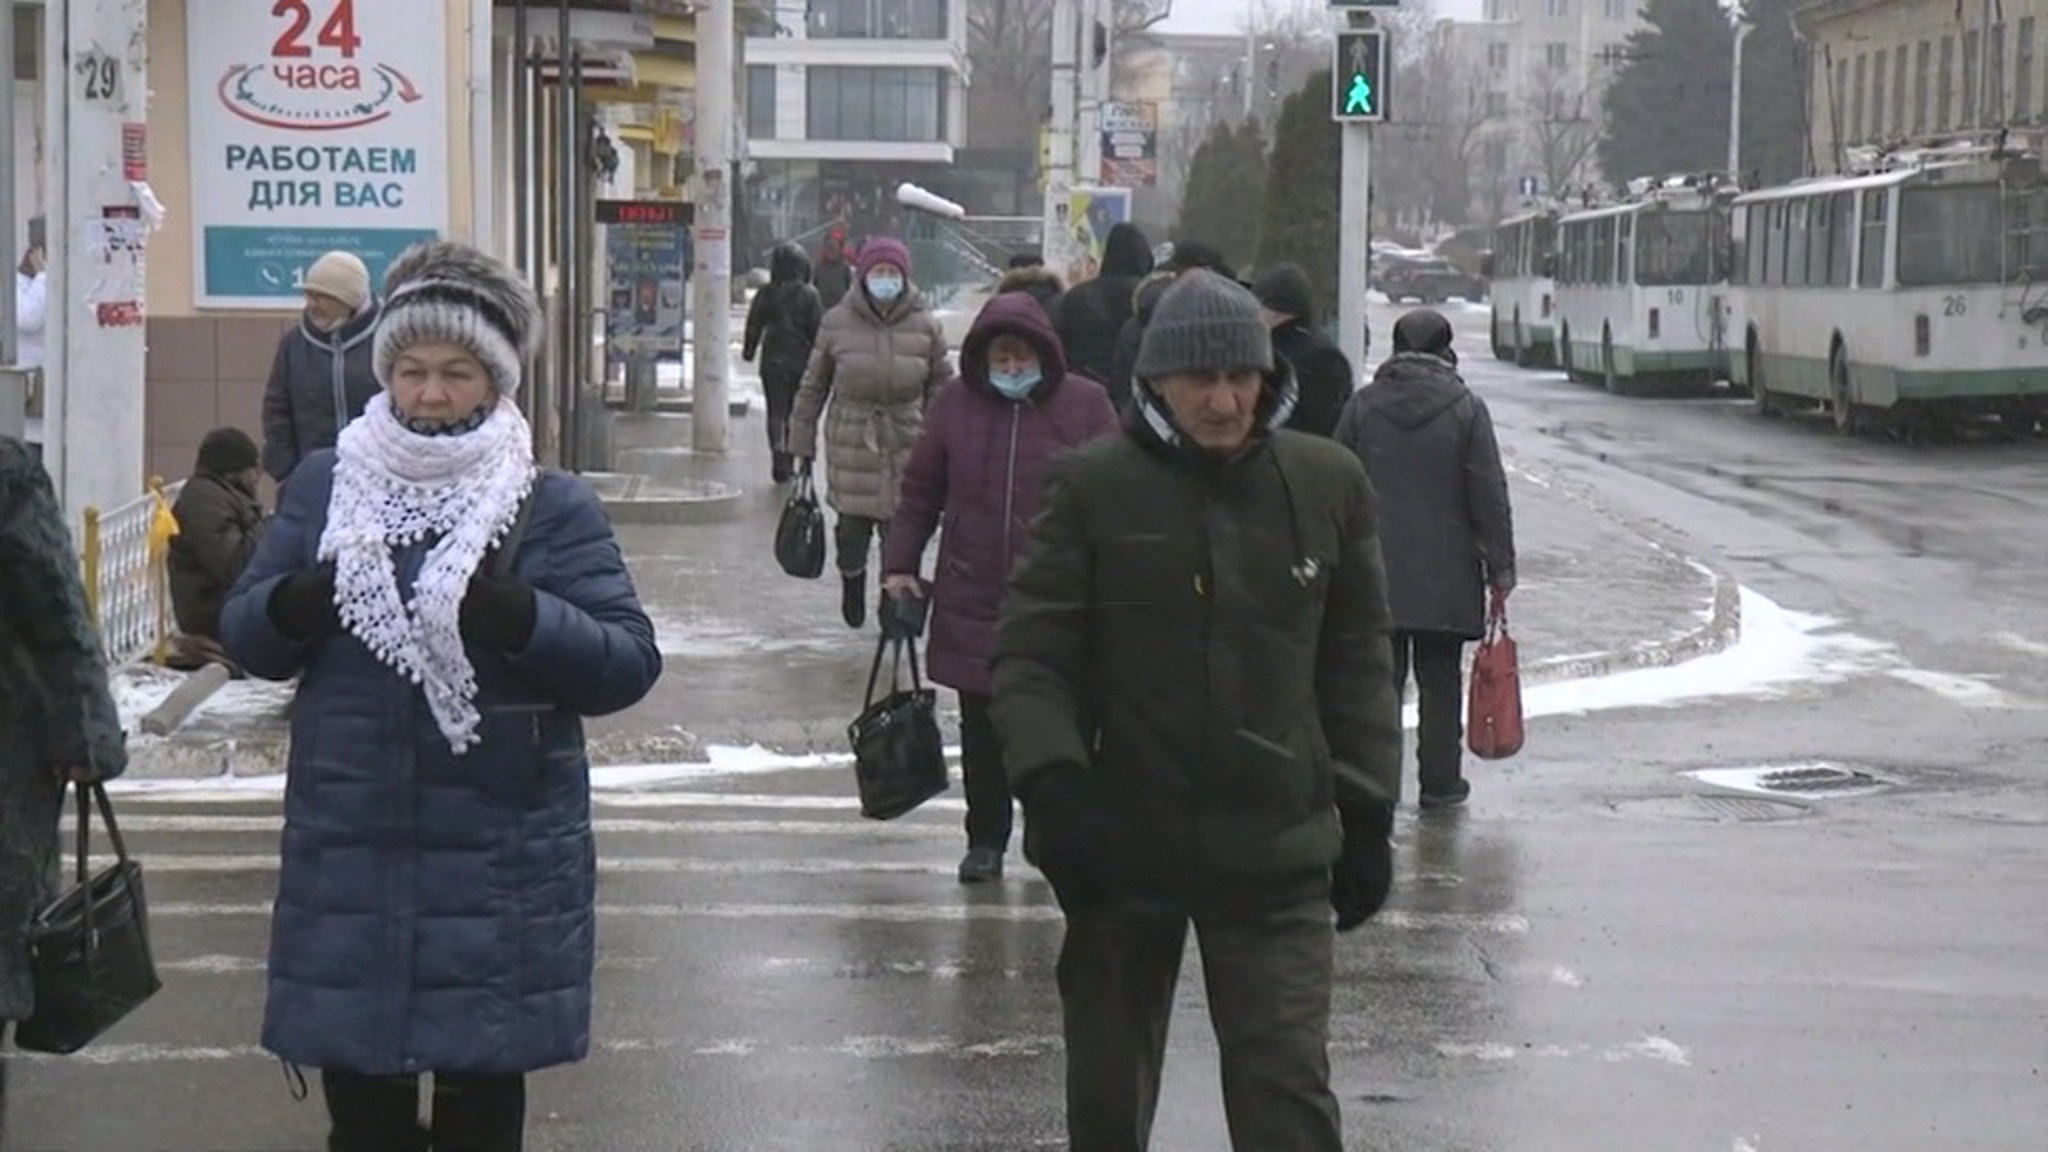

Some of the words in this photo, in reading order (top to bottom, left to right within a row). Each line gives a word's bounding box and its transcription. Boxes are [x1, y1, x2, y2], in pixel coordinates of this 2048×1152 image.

[271, 0, 361, 58] 24
[84, 56, 115, 99] 29
[273, 64, 361, 89] часа
[225, 144, 416, 174] РАБОТАЕМ
[248, 180, 321, 210] ДЛЯ
[335, 181, 404, 208] ВАС
[1943, 294, 1967, 317] 26
